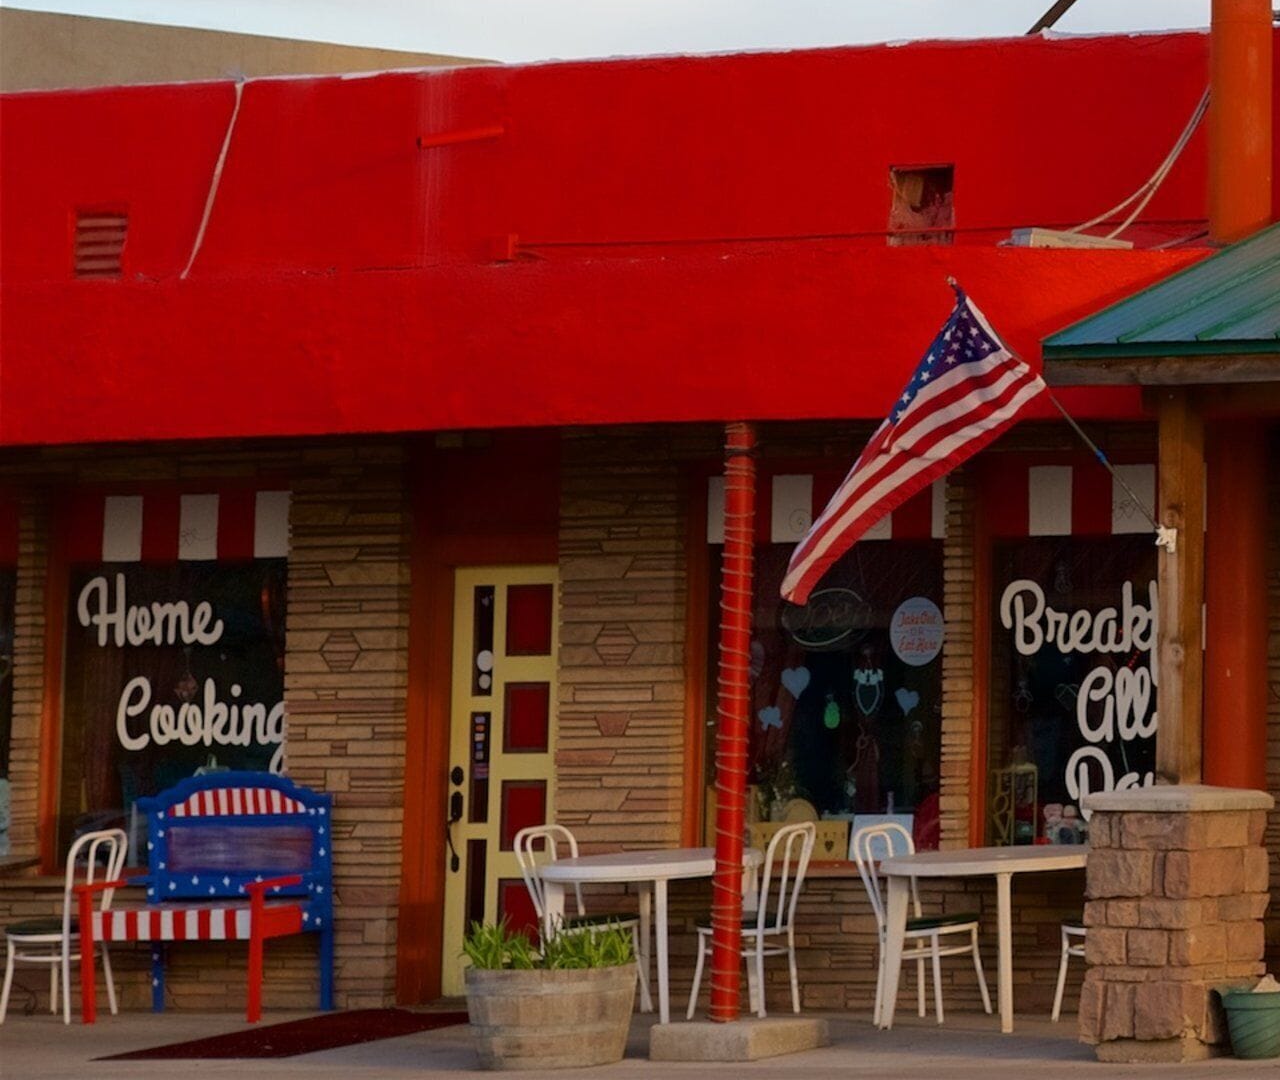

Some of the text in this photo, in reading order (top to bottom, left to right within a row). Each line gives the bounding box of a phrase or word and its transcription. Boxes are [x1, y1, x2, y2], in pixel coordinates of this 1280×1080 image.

[77, 573, 224, 647] Home
[116, 676, 290, 777] Cooking
[1076, 666, 1158, 743] All
